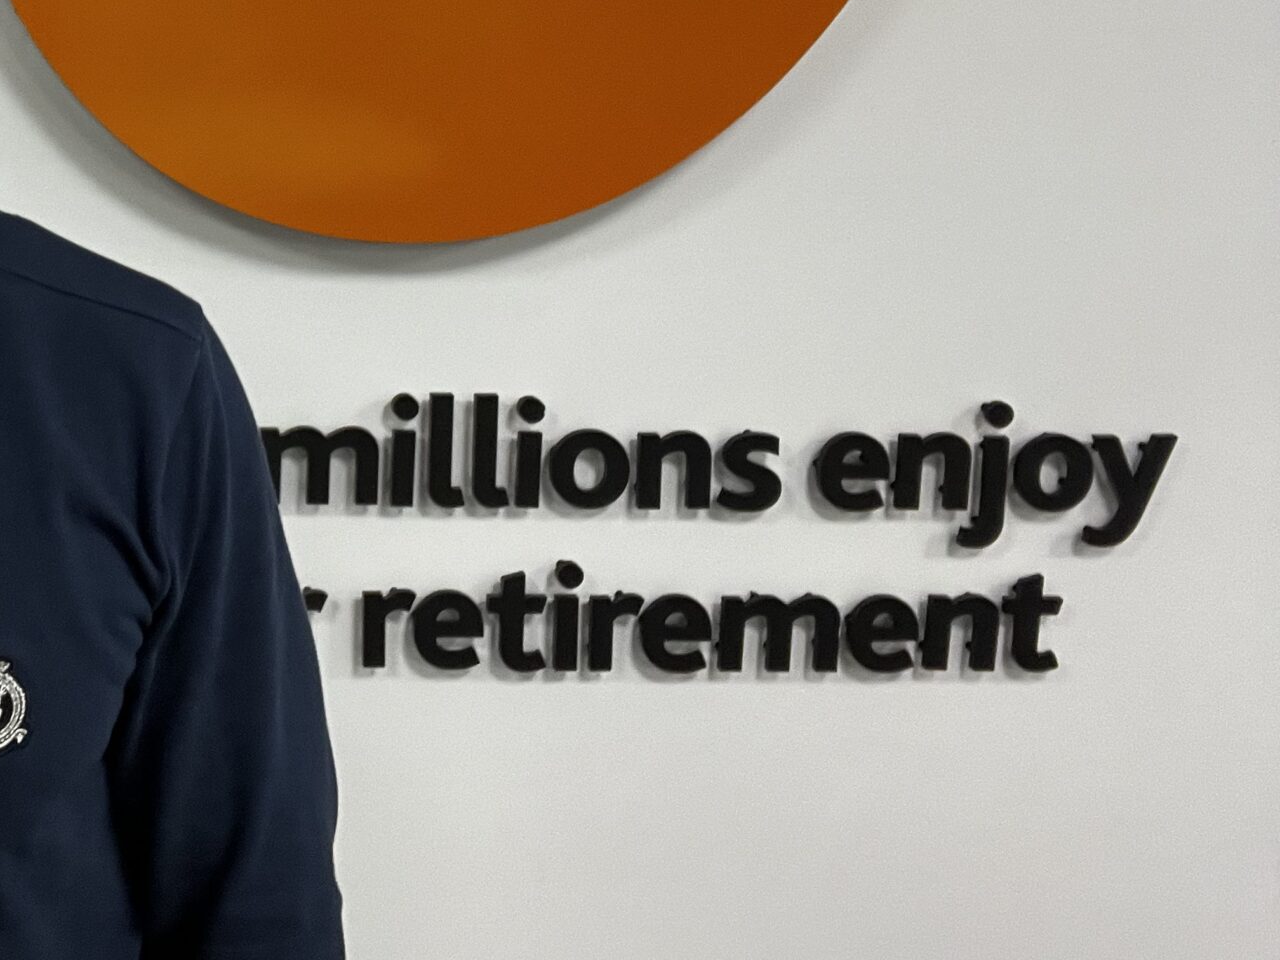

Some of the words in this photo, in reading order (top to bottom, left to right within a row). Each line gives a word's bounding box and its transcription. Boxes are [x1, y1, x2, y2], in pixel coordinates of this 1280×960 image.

[260, 392, 781, 512] millions
[816, 400, 1178, 547] enjoy
[362, 560, 1064, 672] retirement
